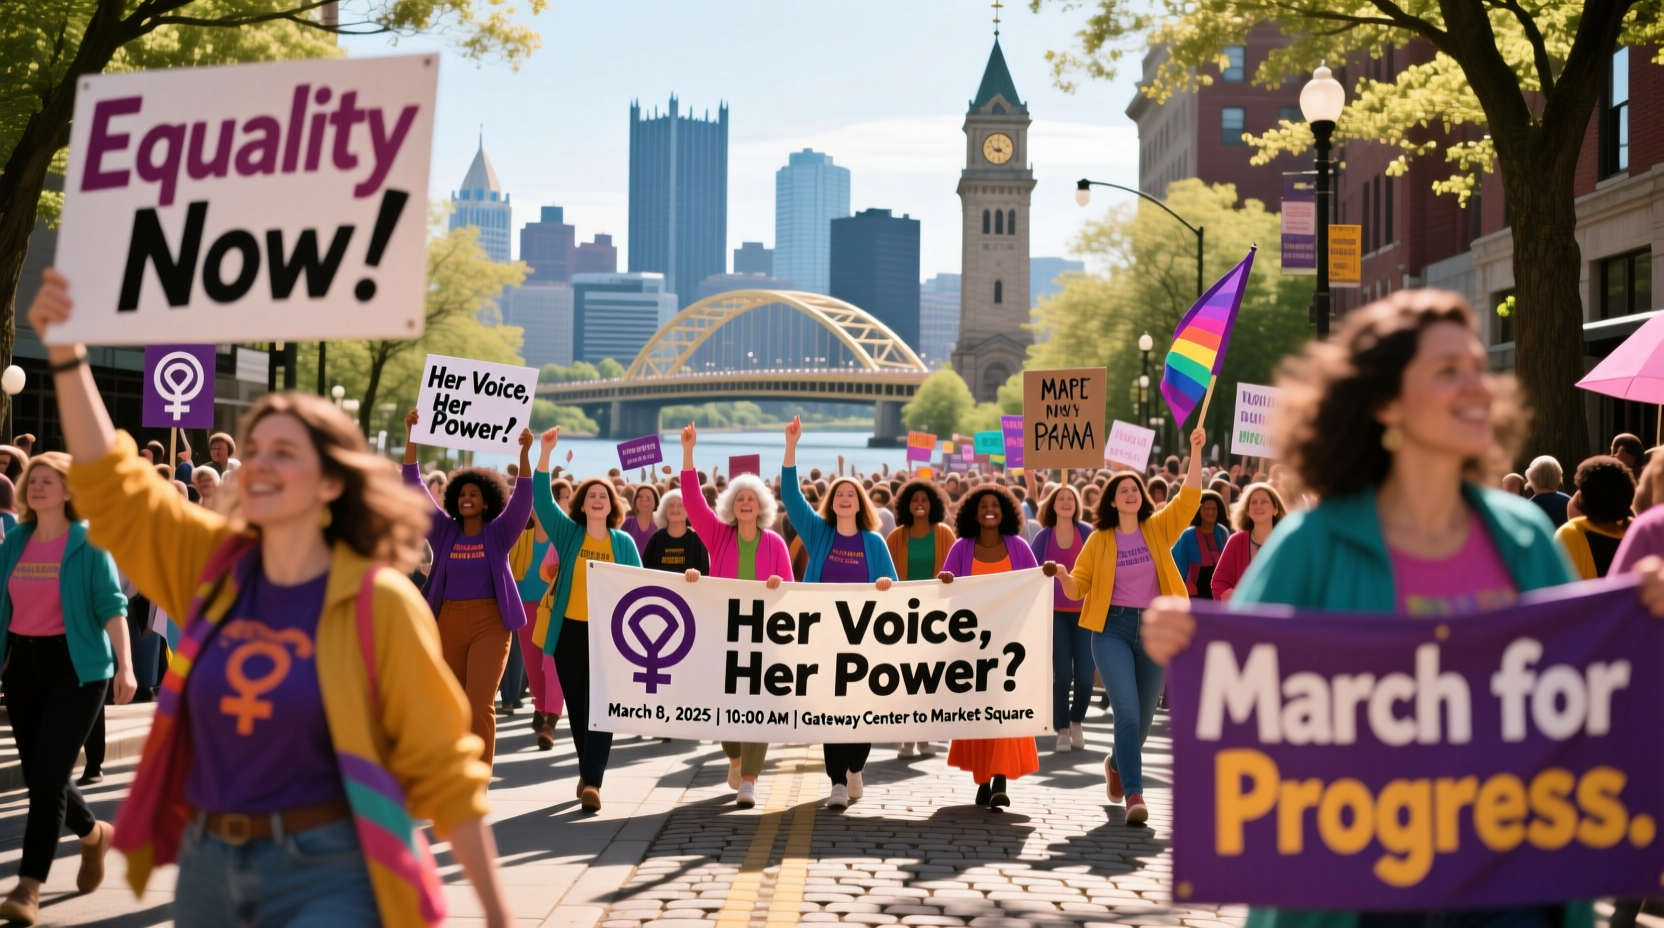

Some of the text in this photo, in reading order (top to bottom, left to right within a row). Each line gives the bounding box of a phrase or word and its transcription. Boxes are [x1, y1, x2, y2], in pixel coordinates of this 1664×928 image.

[80, 83, 421, 207] Equality
[116, 188, 411, 314] Now!
[427, 365, 530, 405] Her Voice,
[432, 393, 472, 416] Her
[430, 410, 518, 443] Power!
[726, 597, 993, 650] Her Voice,
[724, 641, 1026, 697] Her Power?
[1196, 638, 1631, 746] March for
[608, 702, 652, 719] March
[655, 704, 670, 723] 8,
[675, 706, 711, 722] 2025
[725, 709, 764, 724] 10:00
[767, 710, 789, 725] AM
[801, 711, 861, 729] Gateway
[862, 710, 911, 725] Center
[913, 710, 928, 723] to
[930, 707, 982, 723] Market
[984, 706, 1034, 724] Square
[1215, 748, 1656, 888] Progress.
